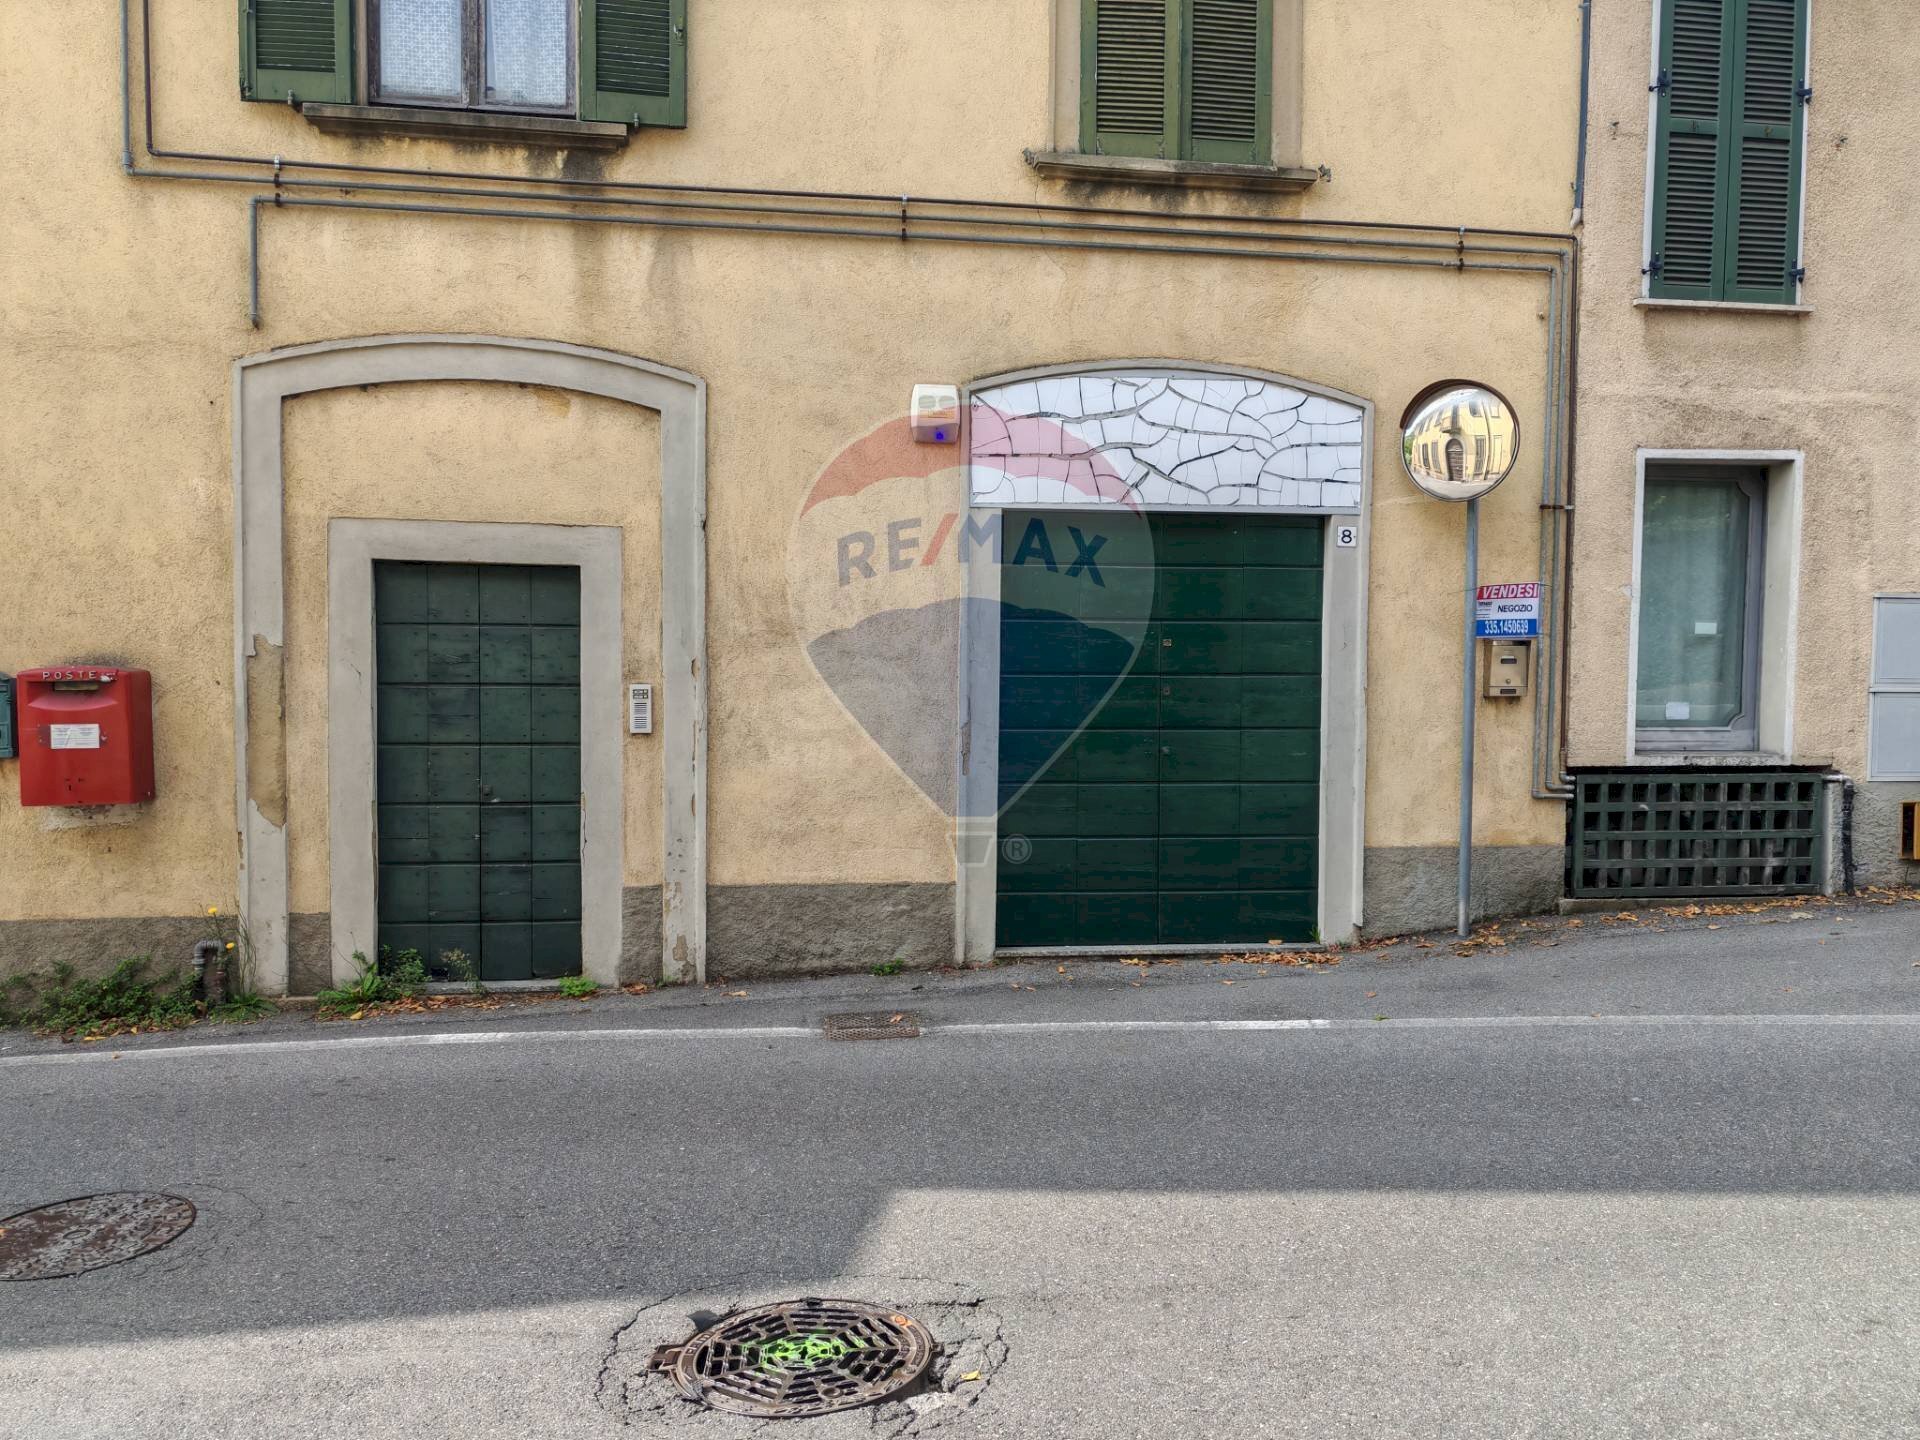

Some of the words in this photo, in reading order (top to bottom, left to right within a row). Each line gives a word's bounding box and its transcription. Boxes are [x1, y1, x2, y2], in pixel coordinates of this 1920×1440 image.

[1341, 529, 1352, 544] 8
[1483, 584, 1538, 599] VENDESI
[1497, 604, 1533, 613] NEGOZIO
[42, 671, 97, 680] POSTE
